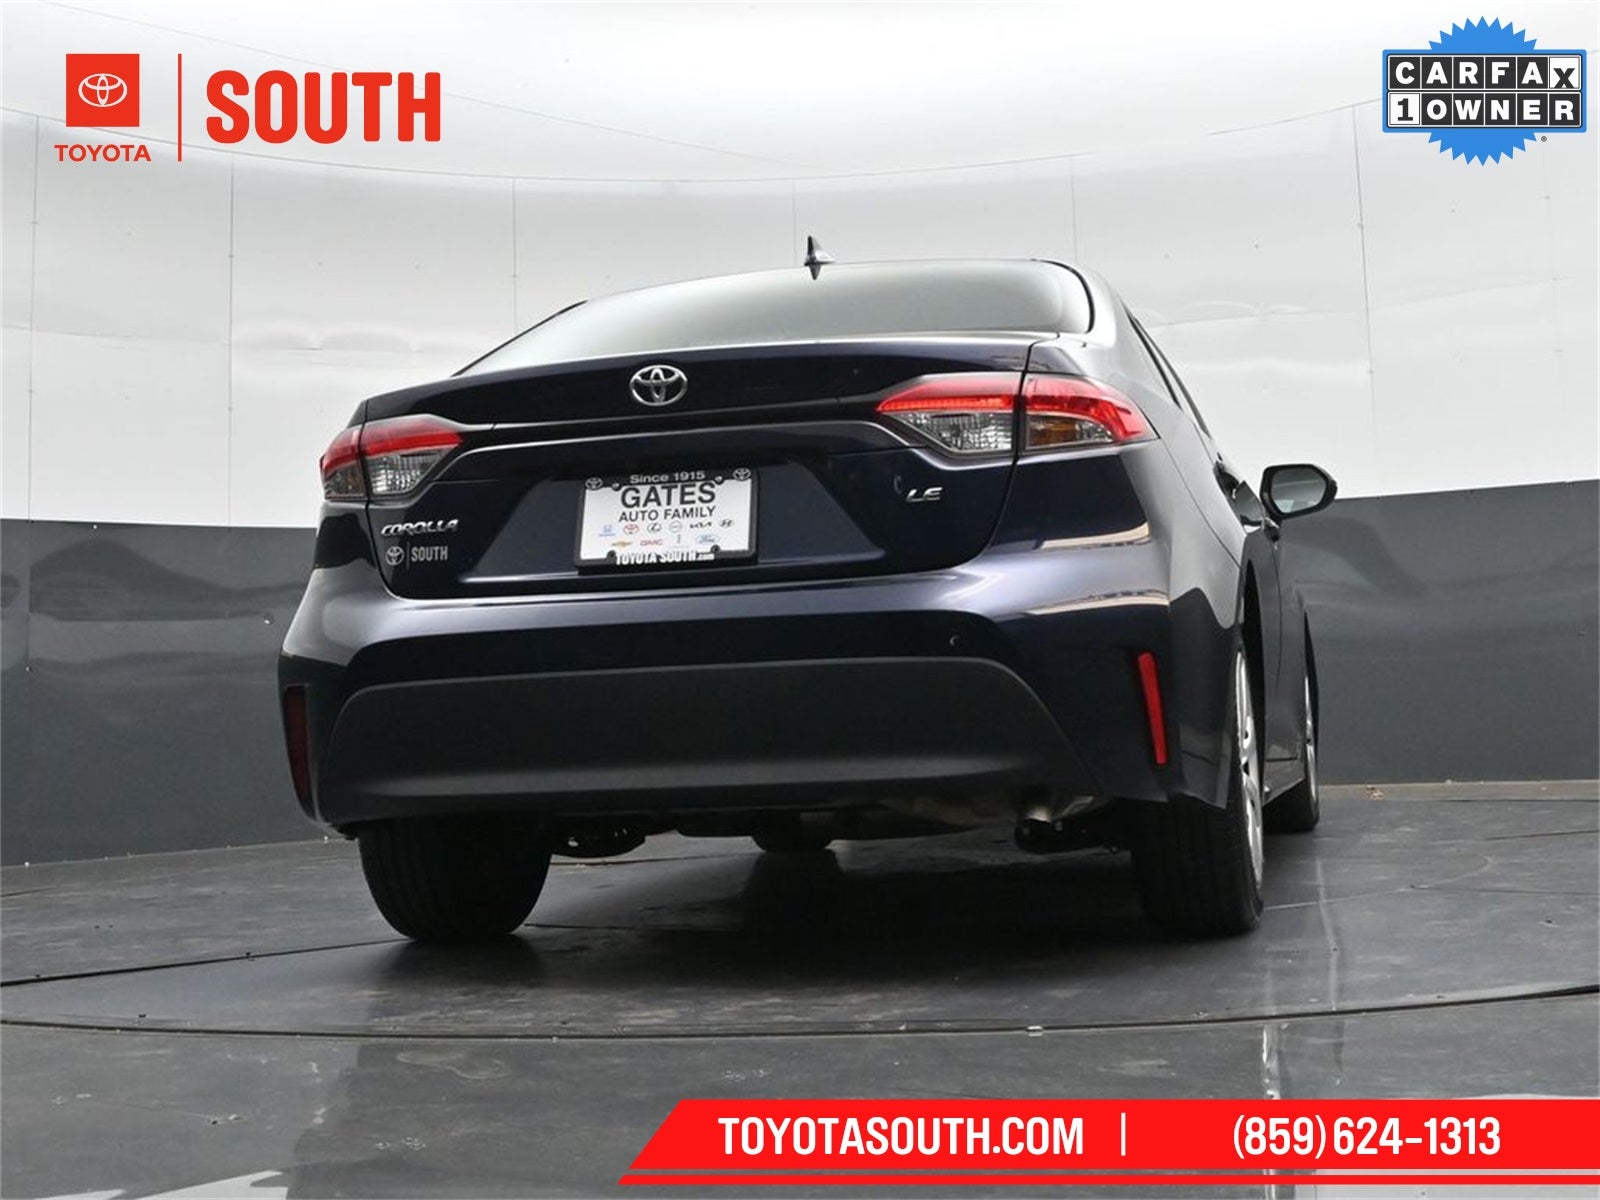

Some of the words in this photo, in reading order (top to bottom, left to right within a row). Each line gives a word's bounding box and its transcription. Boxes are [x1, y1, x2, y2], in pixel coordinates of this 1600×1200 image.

[629, 474, 669, 485] Since
[674, 470, 706, 482] 1915
[620, 481, 717, 509] GATES
[906, 486, 943, 502] LE
[618, 509, 659, 523] AUTO
[663, 505, 717, 521] FAMILY
[381, 519, 459, 536] COROLLA
[411, 545, 449, 562] SOUTH
[615, 551, 658, 566] TOYOTA
